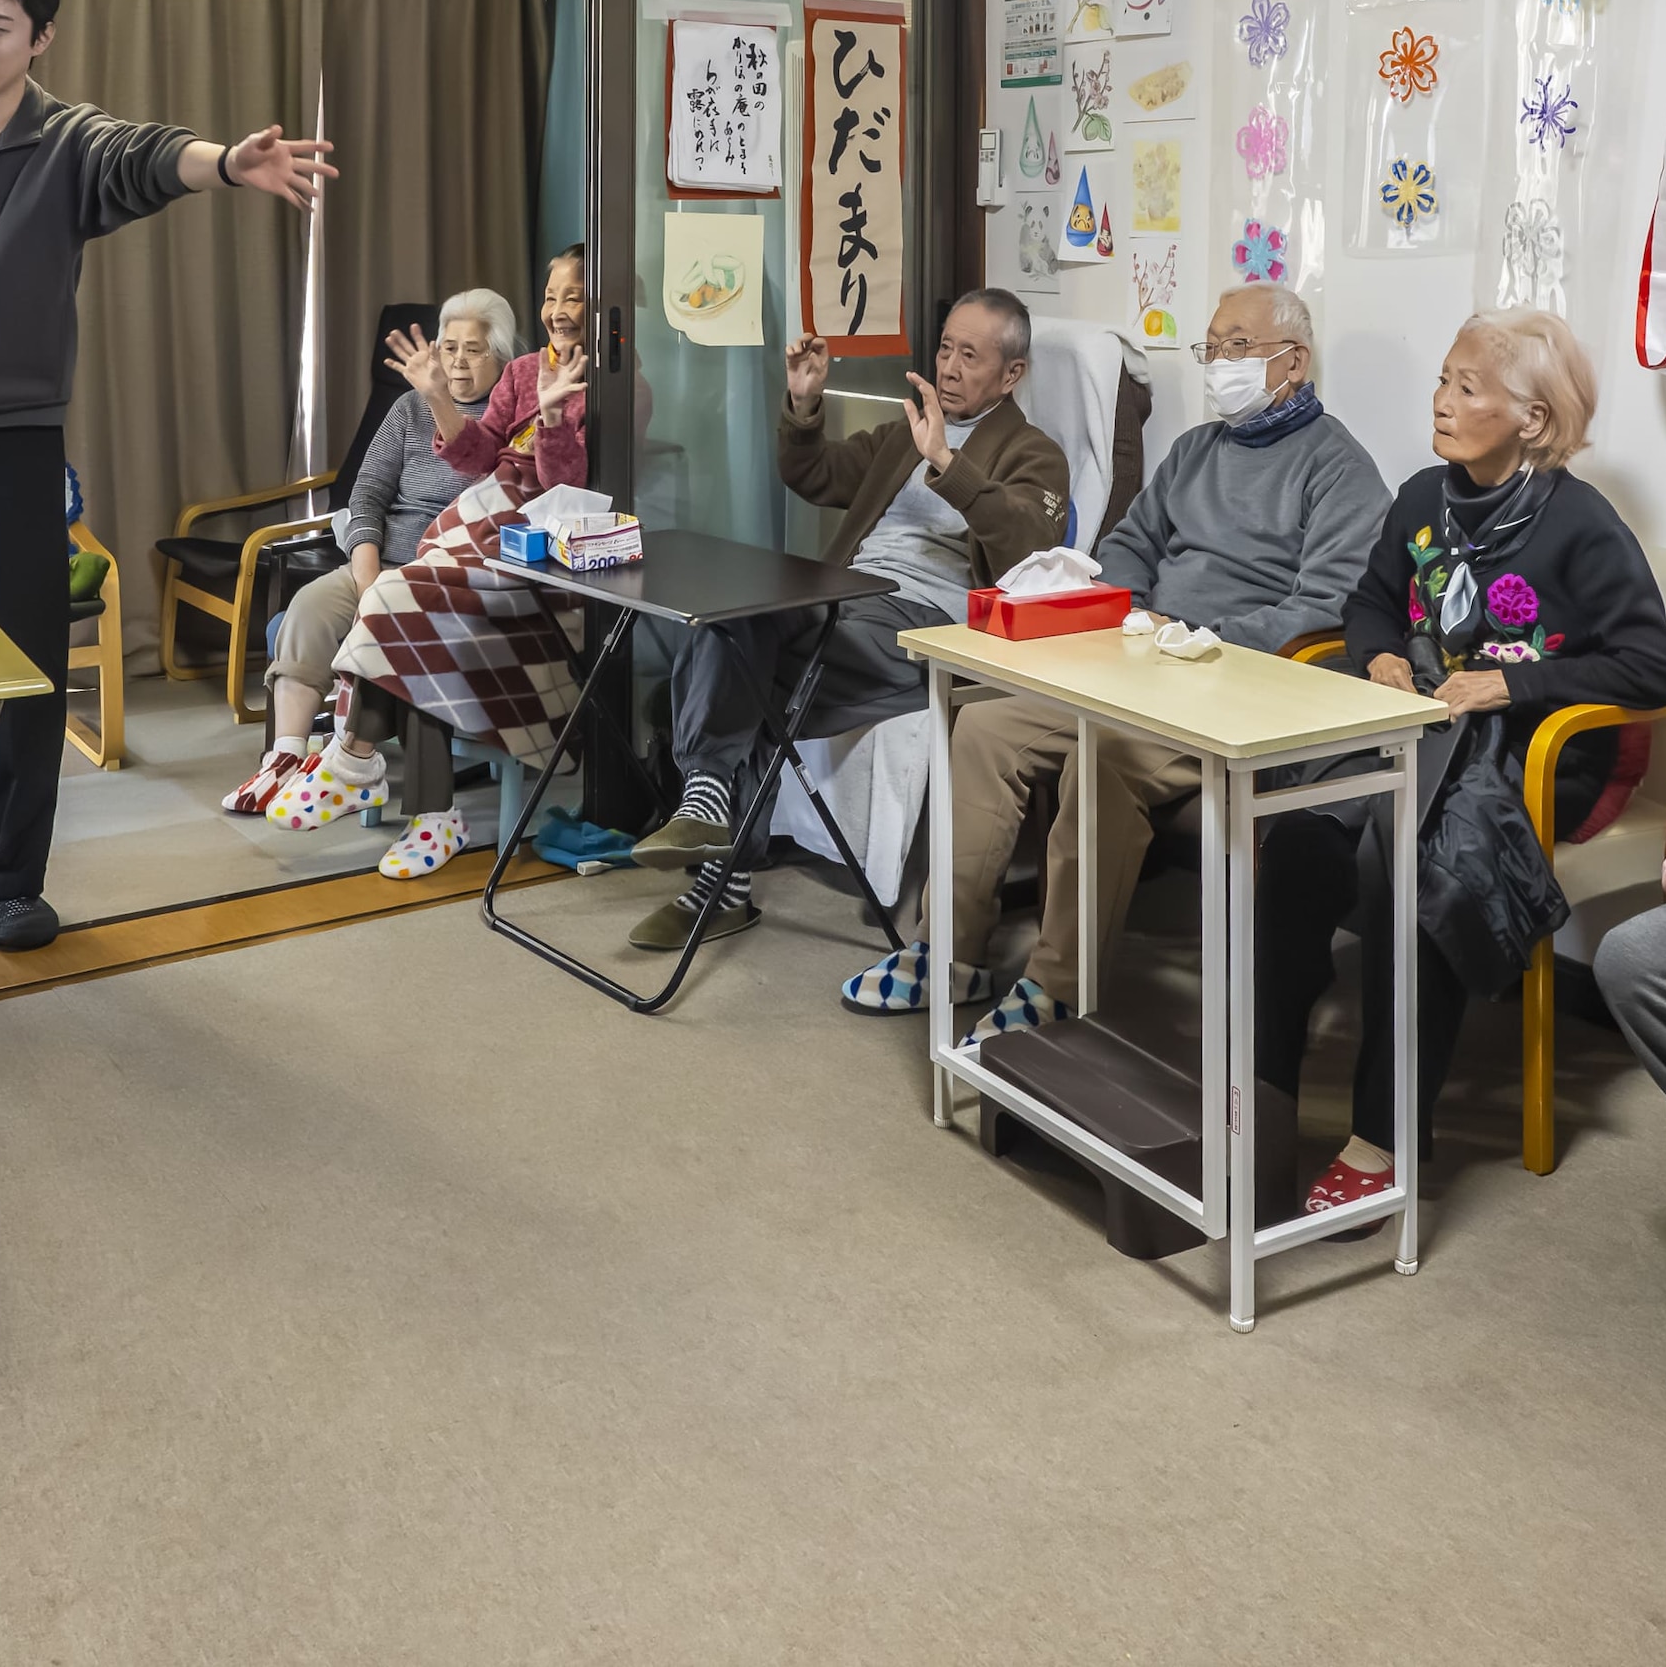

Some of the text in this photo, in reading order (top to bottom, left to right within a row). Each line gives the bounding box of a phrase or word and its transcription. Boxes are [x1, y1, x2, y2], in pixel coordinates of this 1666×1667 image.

[745, 42, 769, 112] 秋の田の
[828, 29, 892, 337] ひだまり
